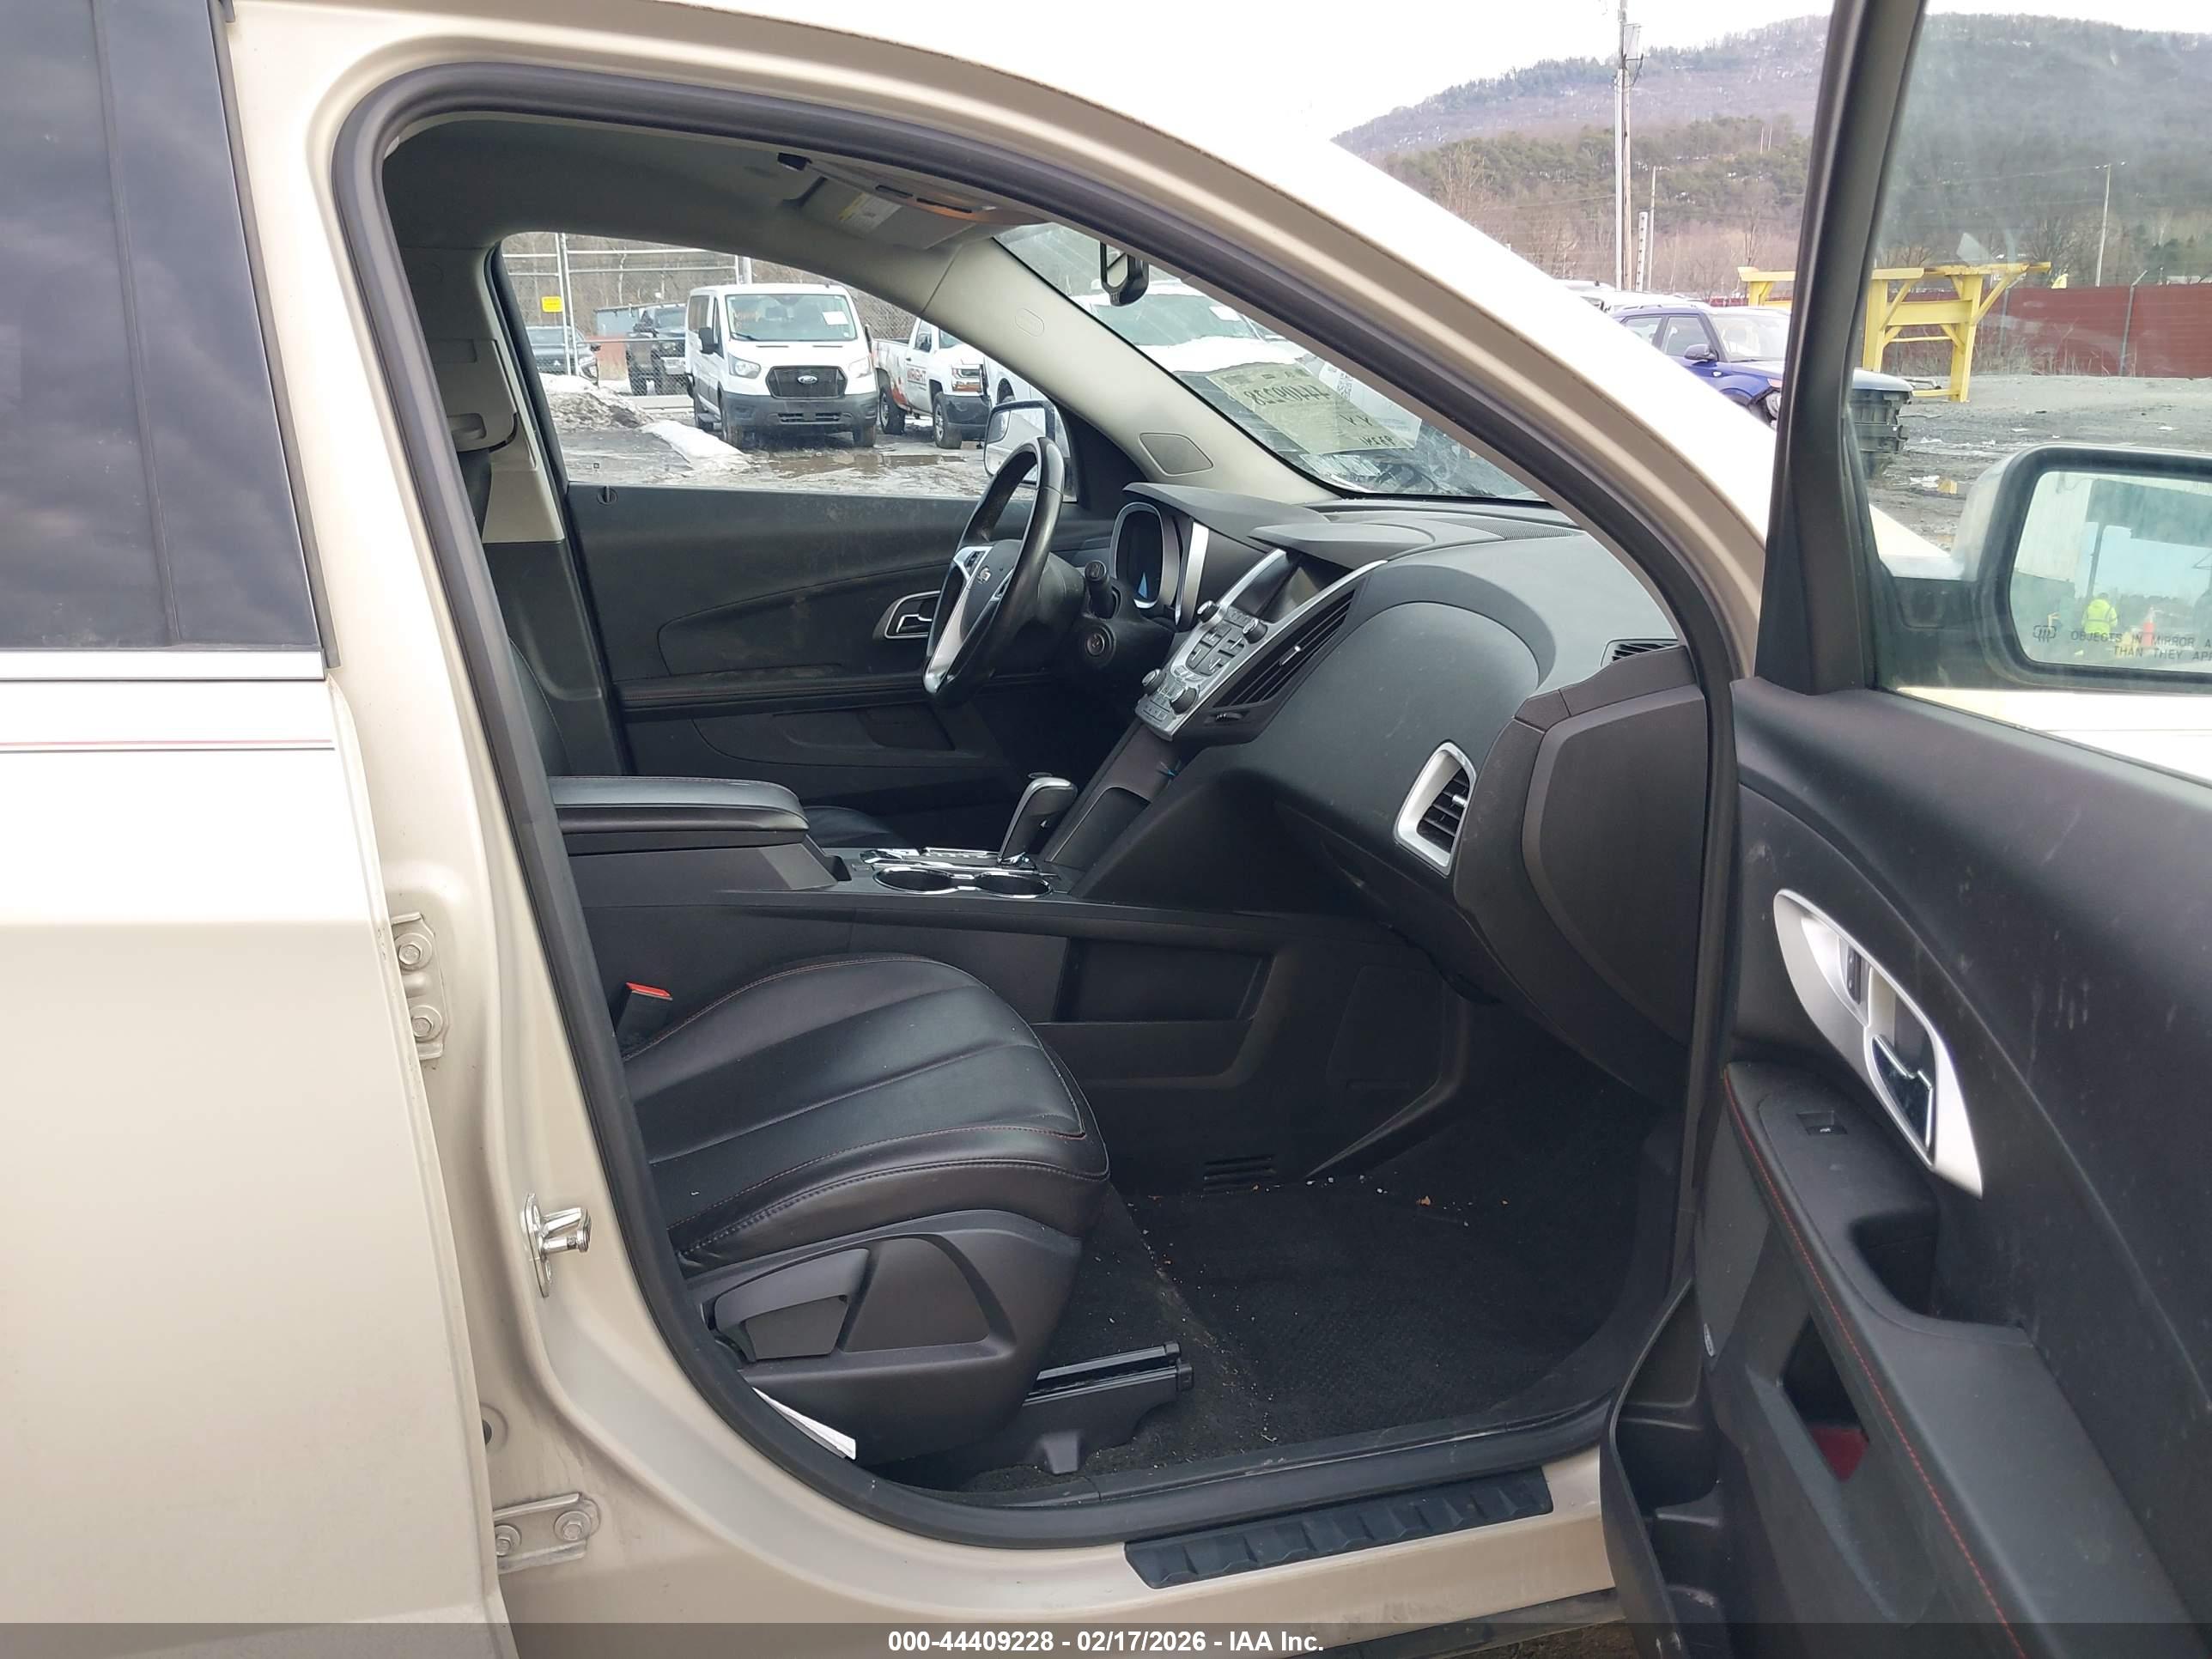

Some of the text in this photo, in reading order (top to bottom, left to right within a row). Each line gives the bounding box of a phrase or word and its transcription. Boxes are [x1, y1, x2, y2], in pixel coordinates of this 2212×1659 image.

[2070, 630, 2123, 643] OBJECTS
[2131, 634, 2143, 644] IN
[2152, 634, 2195, 647] MIRROR
[2115, 645, 2144, 658] THAN
[2154, 647, 2185, 659] THEY
